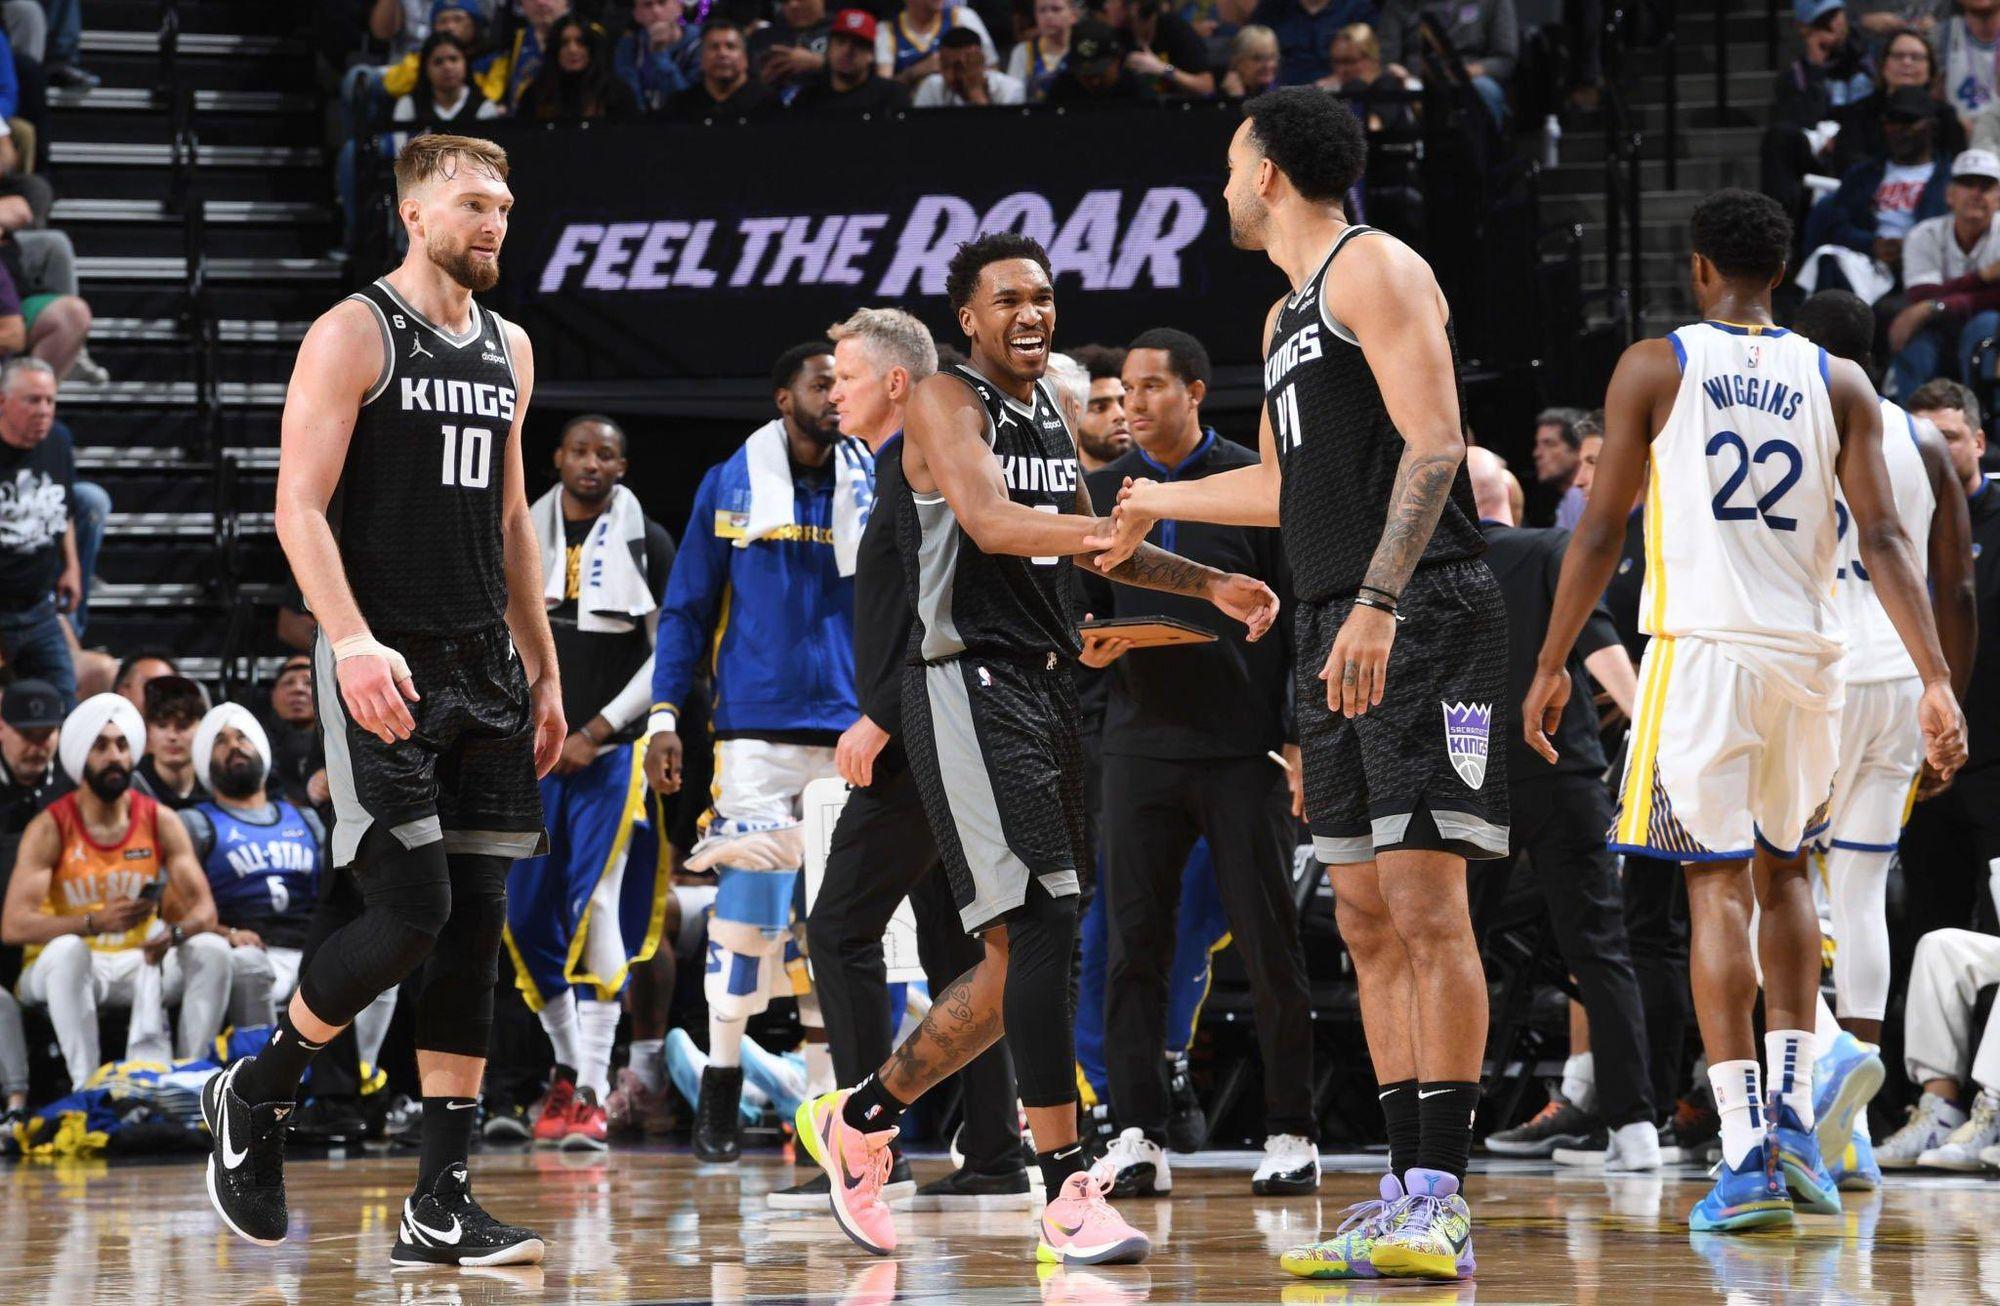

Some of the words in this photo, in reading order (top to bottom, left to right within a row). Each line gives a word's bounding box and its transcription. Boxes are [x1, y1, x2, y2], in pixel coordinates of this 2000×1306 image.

[538, 218, 717, 293] FEEL
[729, 213, 889, 287] THE
[392, 314, 407, 330] 6
[1264, 322, 1323, 391] KINGS
[400, 377, 516, 421] KINGS
[1702, 374, 1803, 421] WIGGINS
[441, 424, 492, 489] 10
[994, 454, 1077, 493] KINGS
[1705, 430, 1803, 532] 22
[1450, 738, 1488, 757] KINGS
[63, 870, 156, 908] ALL-STA
[265, 875, 290, 913] 5
